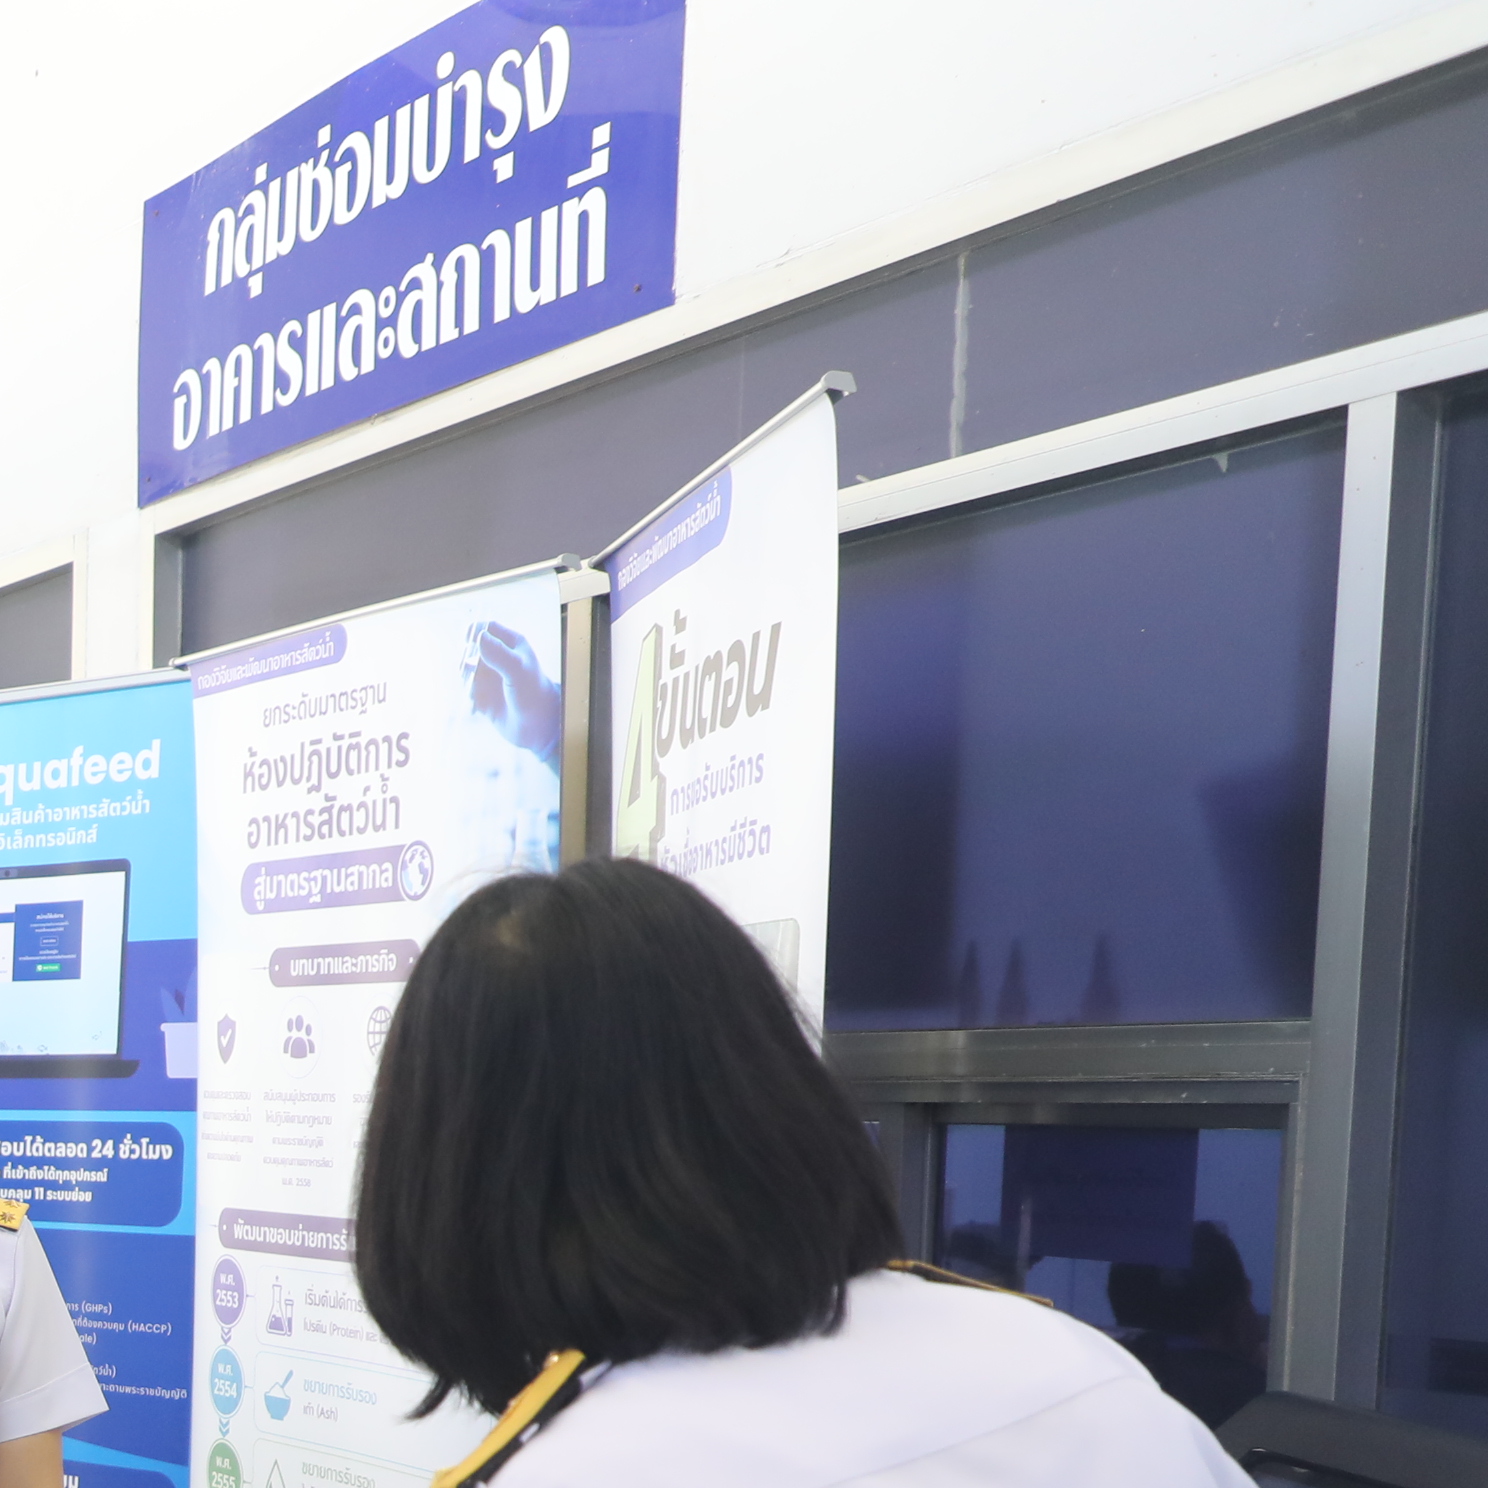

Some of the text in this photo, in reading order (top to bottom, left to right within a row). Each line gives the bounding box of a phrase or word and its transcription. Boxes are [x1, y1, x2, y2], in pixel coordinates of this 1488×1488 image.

[204, 24, 571, 298] กลุ่มซ่อมบำรุง
[172, 121, 612, 451] อาคารและสถานที่
[198, 632, 334, 690] กองวิจัยและพัฒนาอาหารสัตว์น้ำ
[263, 682, 387, 728] ยกระดับมาตรฐาน
[616, 609, 782, 862] 4 ขั้นตอน
[243, 731, 410, 795] ห้องปฏิบัติการ
[247, 773, 400, 849] อาหารสัตว์น้ำ
[254, 861, 394, 910] สู่มาตรฐานสากล
[290, 949, 397, 976] บทบาทและภารกิจ
[91, 1139, 114, 1158] 24
[119, 1133, 173, 1159] ชั่วโมง
[3, 1162, 108, 1184] ที่เข้าถึงได้ทุกอุปกรณ์
[34, 1187, 44, 1200] 11
[46, 1186, 93, 1202] ระบบย่อย
[220, 1273, 235, 1286] พ.ศ.
[81, 1301, 112, 1315] (GHPs)
[216, 1289, 239, 1308] 2553
[79, 1332, 97, 1345] ale)
[127, 1320, 172, 1336] (HACCP)
[329, 1321, 364, 1341] (Protein)
[217, 1363, 233, 1376] พ.ศ.
[101, 1383, 187, 1400] าะตามพระราชบัญญัติ
[214, 1378, 238, 1399] 2554
[304, 1379, 377, 1405] ขยายการรับรอง
[316, 1403, 338, 1422] (Ash)
[216, 1456, 231, 1469] พ.ศ.
